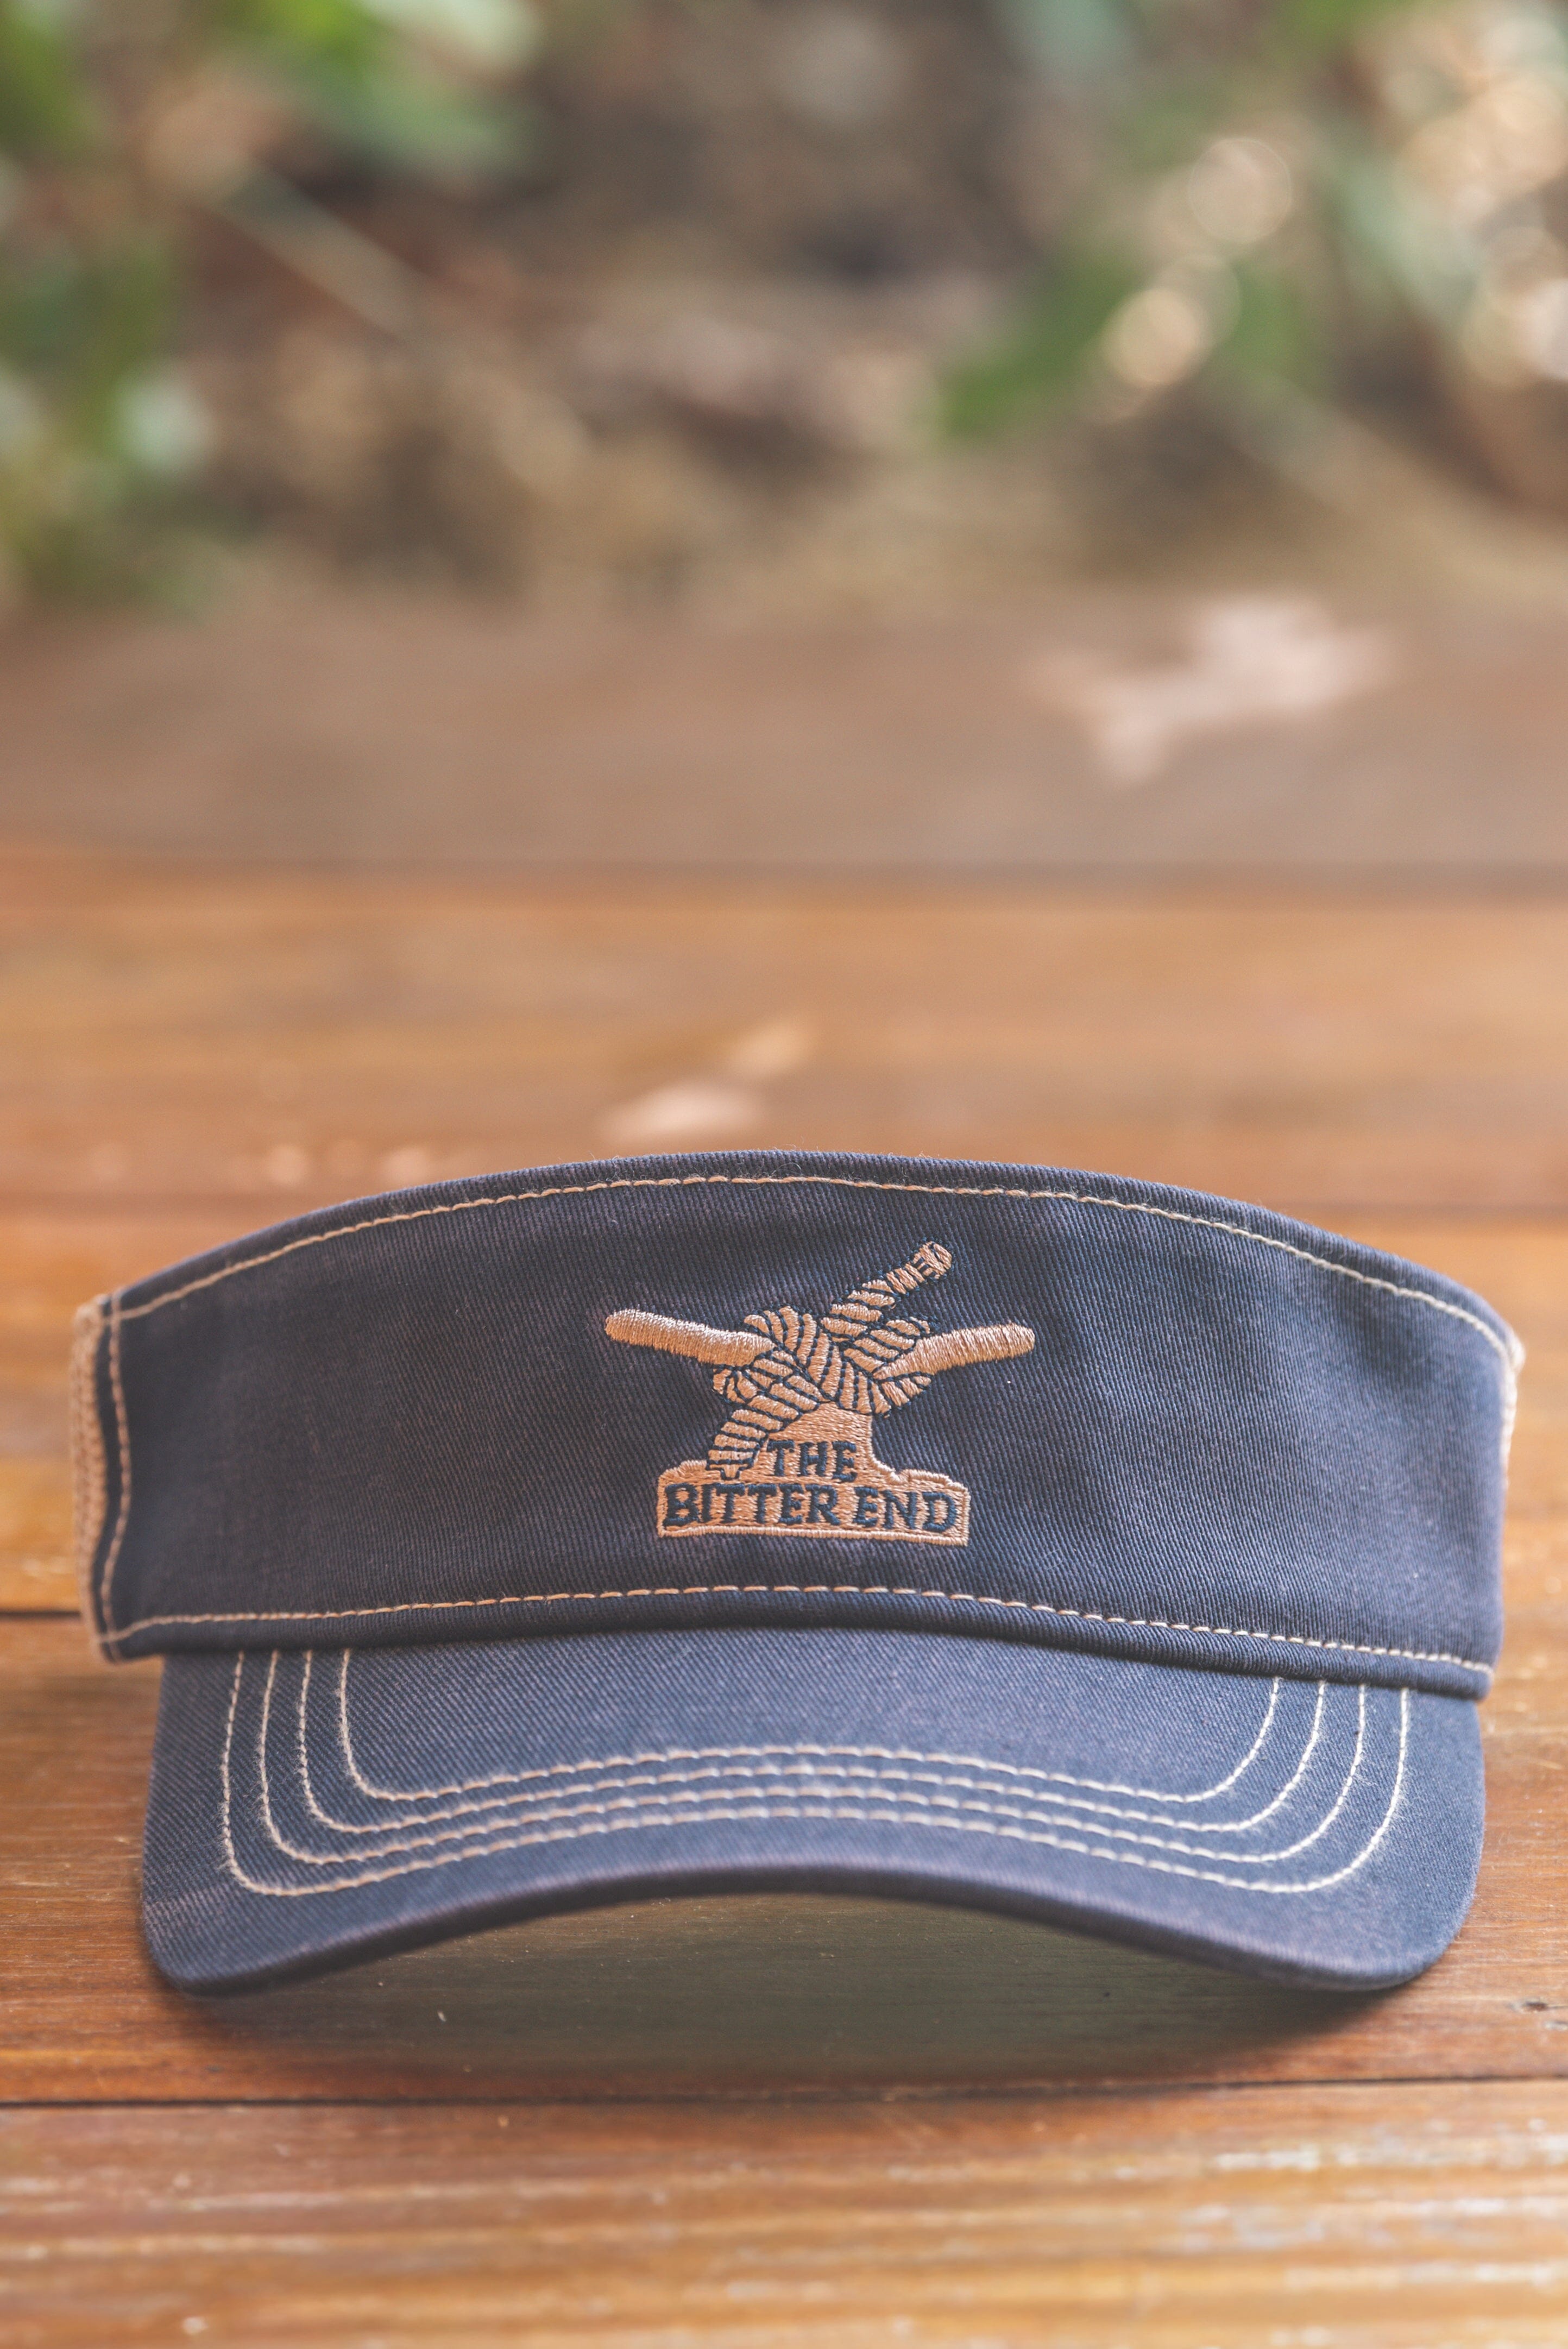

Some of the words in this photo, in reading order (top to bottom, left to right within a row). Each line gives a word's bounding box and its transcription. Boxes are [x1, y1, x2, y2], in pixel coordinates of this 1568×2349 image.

[766, 1440, 857, 1482] THE
[662, 1483, 840, 1526] BITTER
[852, 1486, 957, 1532] END
